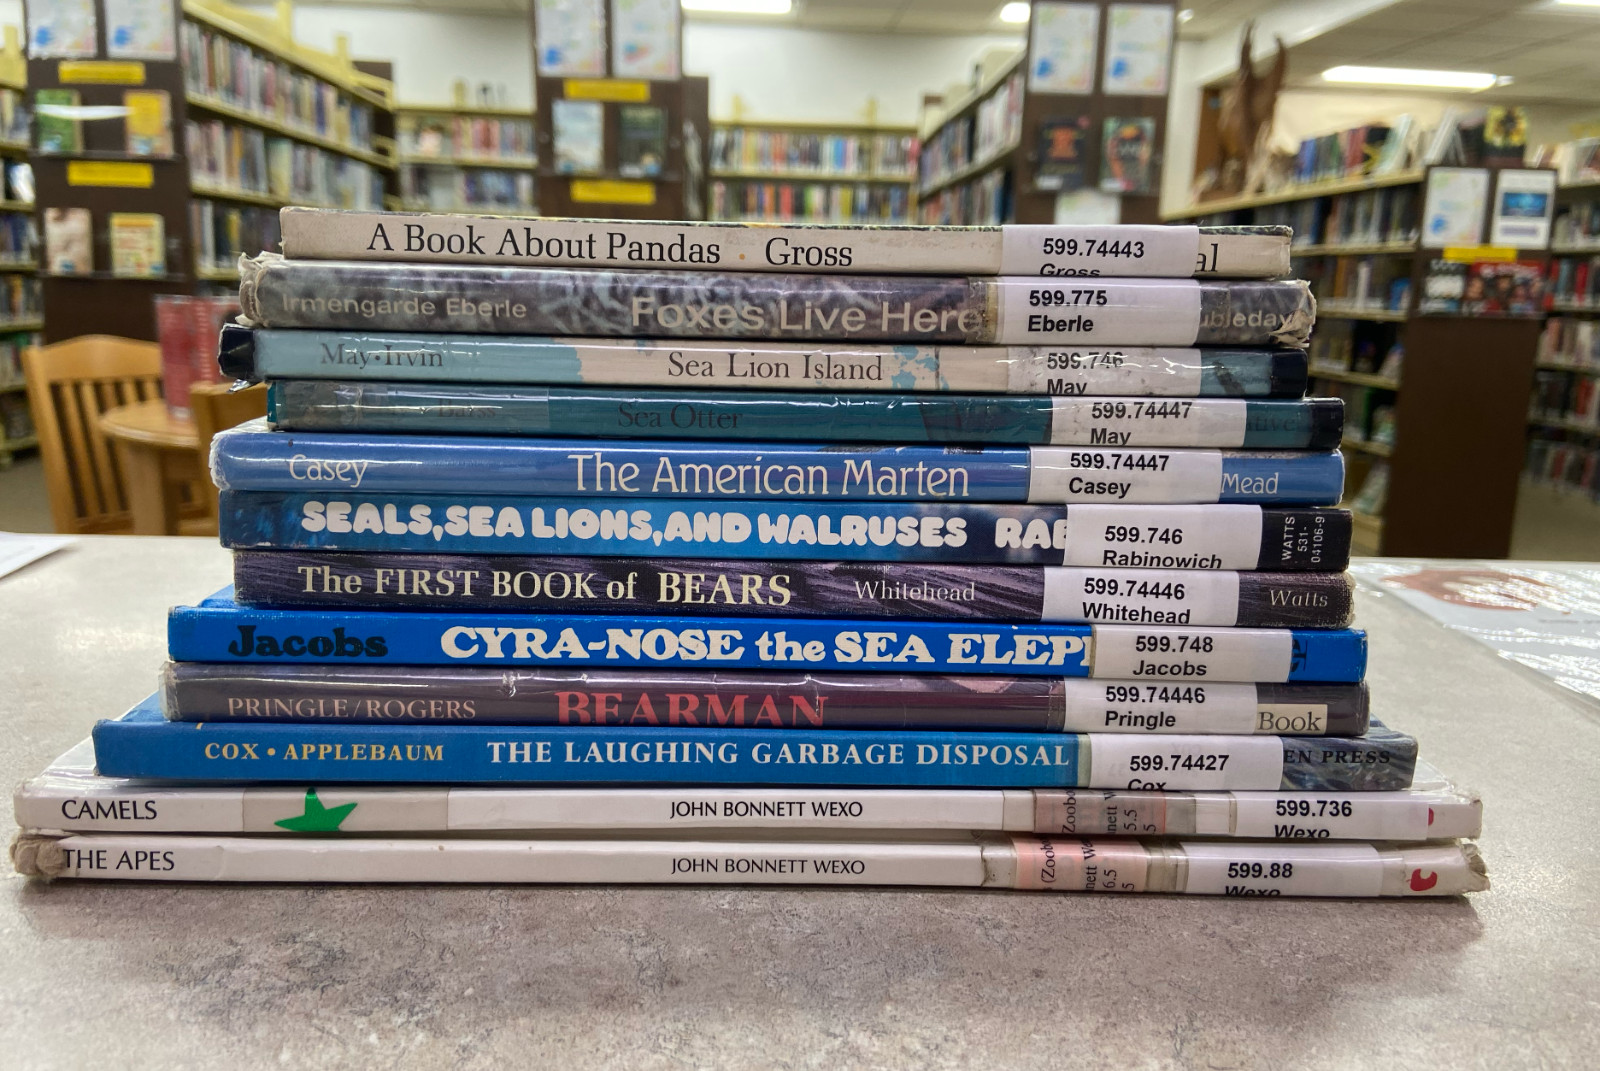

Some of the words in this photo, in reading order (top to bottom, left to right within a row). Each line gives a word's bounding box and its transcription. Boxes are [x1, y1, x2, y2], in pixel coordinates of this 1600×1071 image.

[367, 223, 394, 251] A
[404, 224, 485, 256] Book
[496, 227, 597, 260] About
[606, 232, 721, 265] Pandas
[765, 237, 853, 267] Gross
[1043, 238, 1145, 259] 599.74443
[283, 295, 436, 319] Irmengarde
[446, 298, 527, 319] Eberle
[1029, 290, 1108, 307] 599.775
[631, 296, 765, 330] Foxes
[779, 298, 867, 331] Live
[881, 300, 983, 333] Here
[1027, 314, 1094, 333] Eberle
[668, 351, 714, 378] Sea
[728, 353, 790, 379] Lion
[803, 354, 883, 381] Island
[1046, 351, 1124, 371] 599.746
[1047, 378, 1088, 395] May
[617, 403, 662, 429] Sea
[670, 403, 743, 430] Otter
[1091, 401, 1193, 419] 599.74447
[1090, 428, 1132, 446] May
[289, 453, 369, 488] Casey
[1069, 453, 1170, 471] 599.74447
[567, 452, 641, 492] The
[651, 455, 829, 496] American
[841, 459, 970, 498] Marten
[1220, 472, 1279, 495] Mead
[1068, 477, 1132, 500] Casey
[757, 513, 968, 548] WALRUSES
[1104, 526, 1183, 545] 599.746
[1281, 516, 1296, 560] WATTS
[1297, 526, 1309, 552] 531-
[1310, 516, 1325, 563] 04106-9
[1102, 550, 1222, 570] Rabinowich
[298, 566, 362, 594] The
[374, 568, 480, 597] FIRST
[491, 571, 600, 600] BOOK
[606, 572, 638, 600] of
[656, 572, 792, 606] BEARS
[854, 579, 976, 602] Whitehead
[1084, 578, 1186, 600] 599.74446
[1268, 589, 1329, 608] Watts
[1082, 602, 1191, 625] Whitehead
[228, 625, 389, 658] Jacobs
[440, 625, 745, 662] CYRA-NOSE
[754, 631, 827, 662] the
[834, 631, 936, 664] SEA
[1135, 636, 1214, 653] 599.748
[1132, 660, 1208, 677] Jacobs
[1105, 686, 1206, 704] 599.74446
[554, 691, 829, 727] BEARMAN
[1104, 710, 1177, 728] Pringle
[1258, 710, 1323, 733] Book
[204, 742, 260, 761] COX
[284, 743, 445, 762] APPLEBAUM
[486, 741, 552, 764] THE
[564, 741, 739, 765] LAUGHING
[751, 742, 905, 765] GARBAGE
[915, 744, 1070, 767] DISPOSAL
[1322, 750, 1391, 765] PRESS
[1129, 755, 1230, 772] 599.74427
[61, 799, 158, 820] CAMELS
[670, 801, 718, 819] JOHN
[723, 802, 806, 817] BONNETT
[811, 802, 864, 818] WEXO
[1275, 799, 1353, 817] 599.736
[1124, 809, 1138, 830] 5.5
[1274, 825, 1330, 839] Wexo
[63, 849, 108, 870] THE
[115, 850, 175, 872] APES
[671, 858, 719, 875] JOHN
[724, 859, 808, 875] BONNETT
[813, 860, 866, 875] WEXO
[1227, 862, 1294, 879] 599.88
[1103, 869, 1117, 889] 6.5
